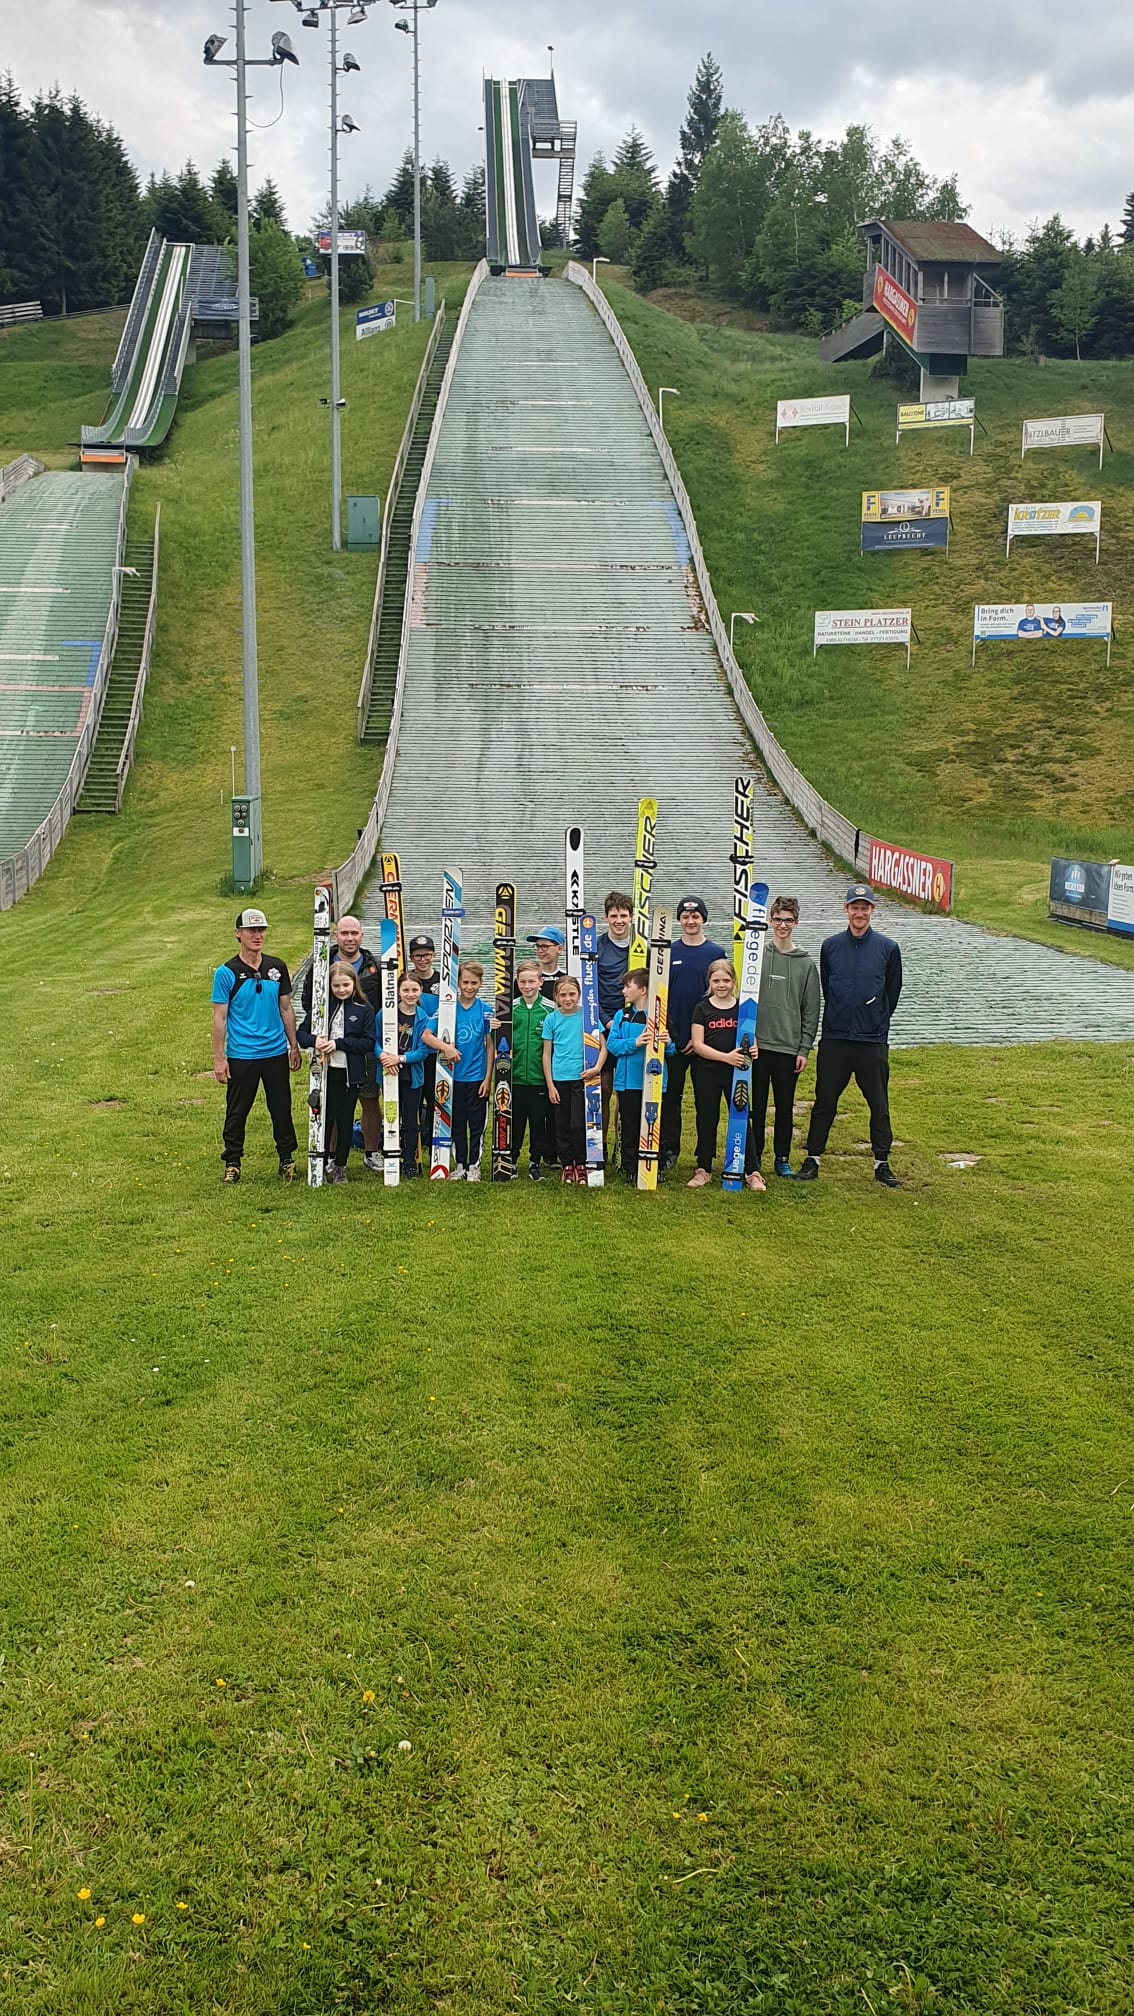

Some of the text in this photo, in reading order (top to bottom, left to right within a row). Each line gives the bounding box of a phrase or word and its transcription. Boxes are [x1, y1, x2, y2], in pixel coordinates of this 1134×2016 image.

[832, 617, 908, 627] STEIN PLATZER
[733, 776, 751, 922] FISCHER
[871, 846, 933, 901] HARGASSNER
[656, 916, 667, 976] GERINA
